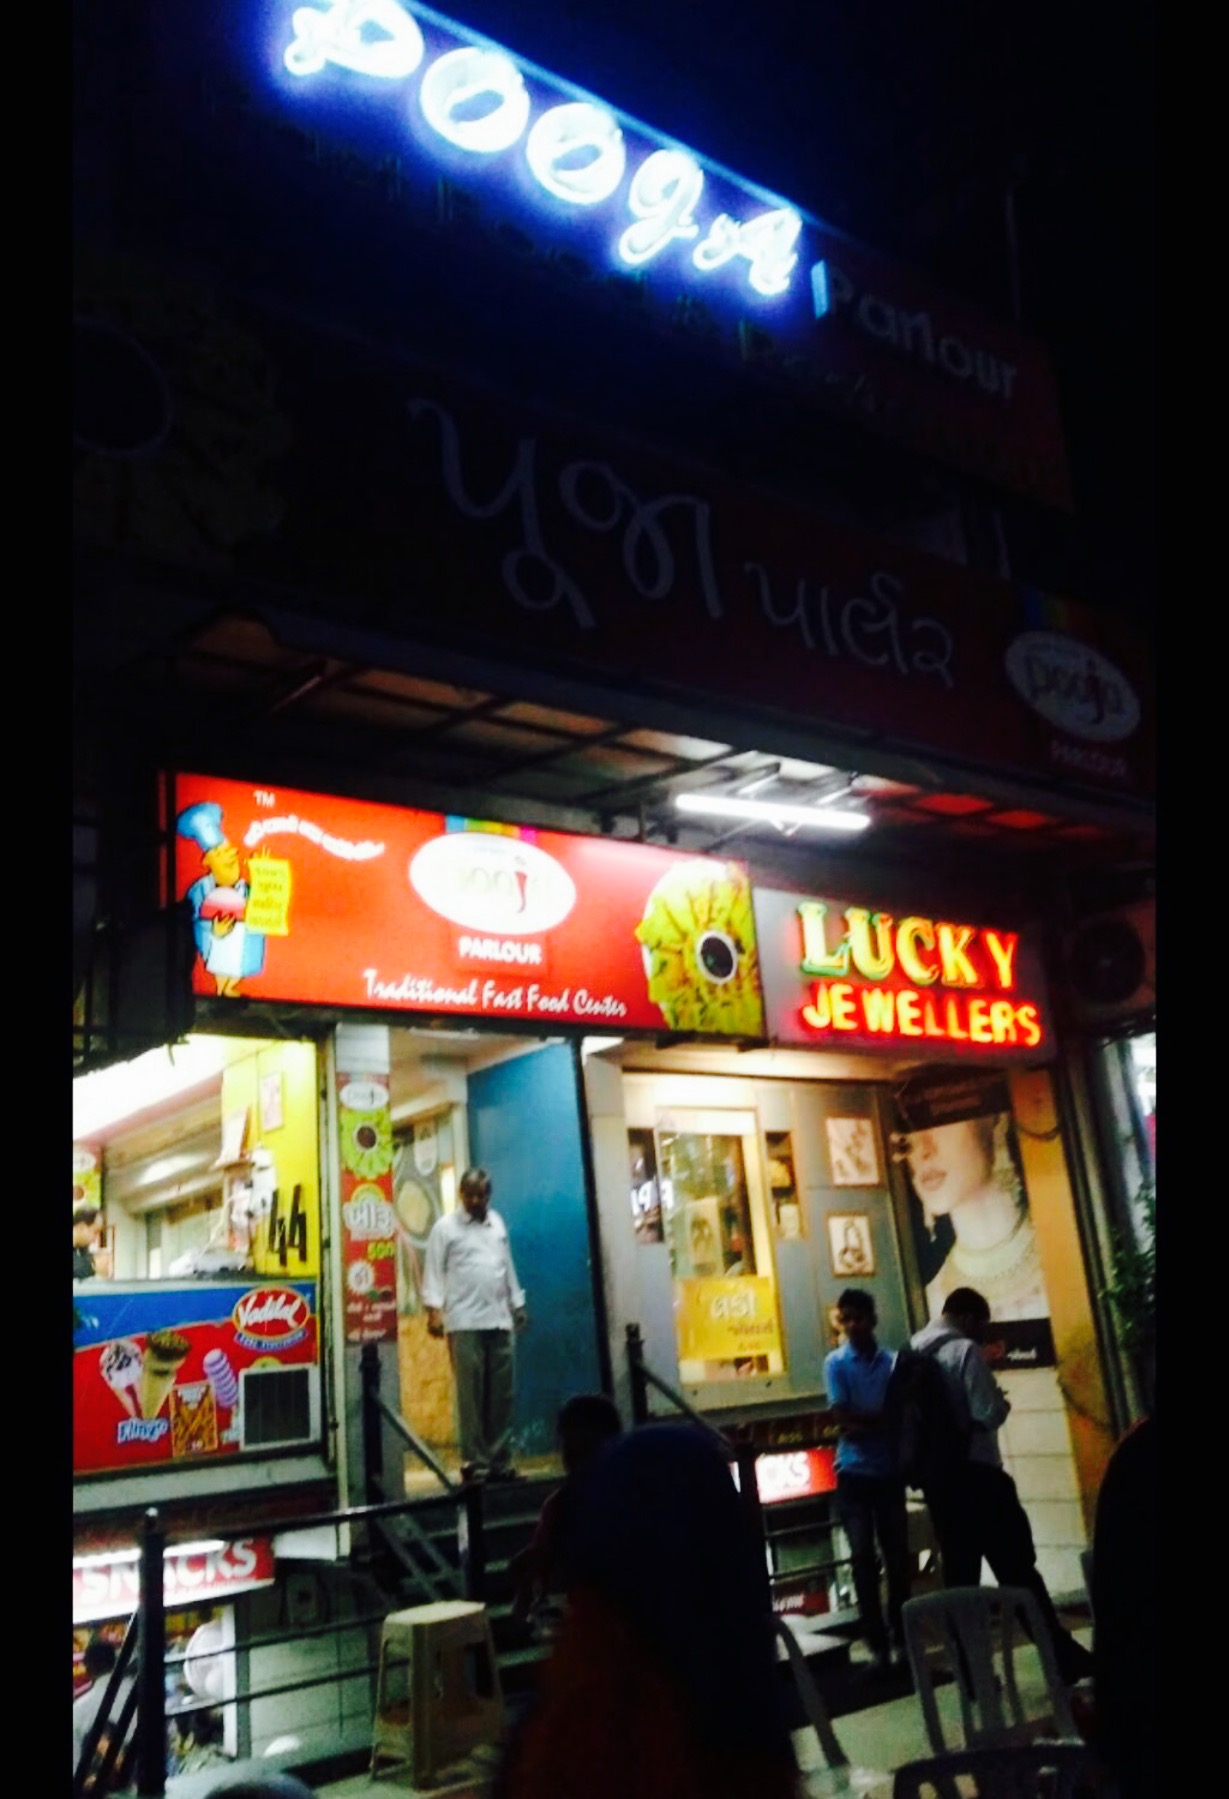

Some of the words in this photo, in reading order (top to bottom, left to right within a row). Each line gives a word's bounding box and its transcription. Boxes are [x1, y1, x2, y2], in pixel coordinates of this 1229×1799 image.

[405, 398, 726, 630] પૂજા
[459, 936, 542, 964] PARLOUR
[797, 901, 1018, 990] LUCKY
[362, 968, 479, 1006] Traditional
[481, 977, 523, 1010] Fast
[527, 983, 569, 1013] Food
[801, 981, 1042, 1046] JEWELLERS
